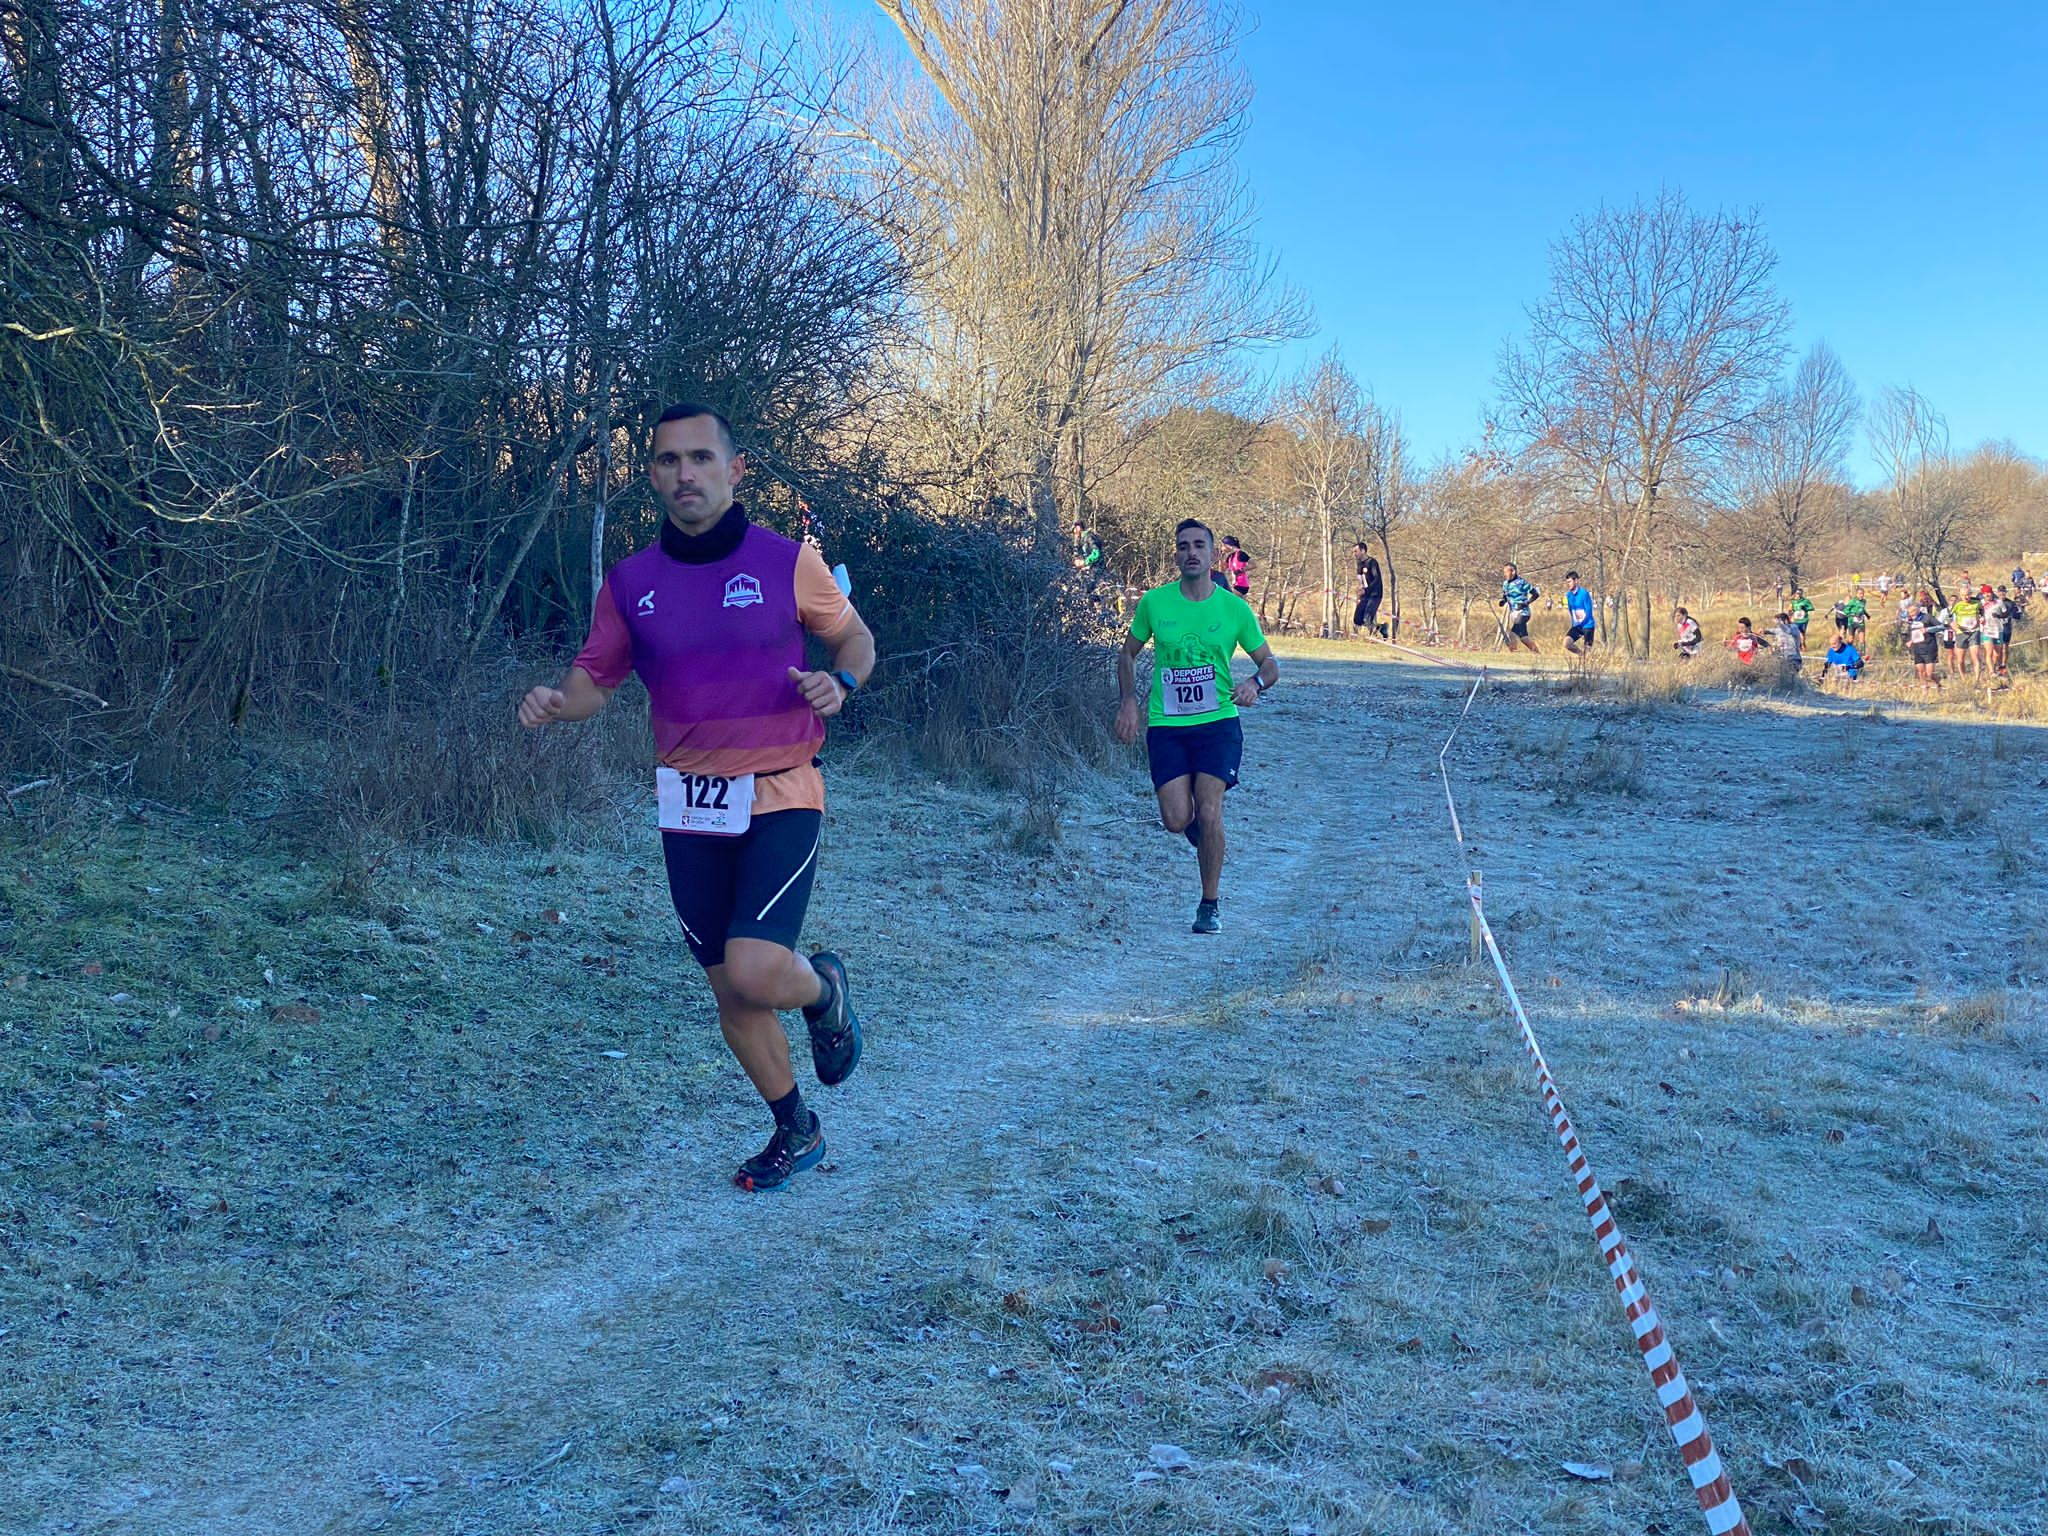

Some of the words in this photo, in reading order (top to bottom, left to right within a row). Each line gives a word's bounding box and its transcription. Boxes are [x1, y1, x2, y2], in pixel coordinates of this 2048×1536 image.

[1174, 666, 1213, 677] DEPORTE
[1192, 674, 1214, 682] TODOS
[1175, 685, 1203, 703] 120
[681, 775, 729, 810] 122
